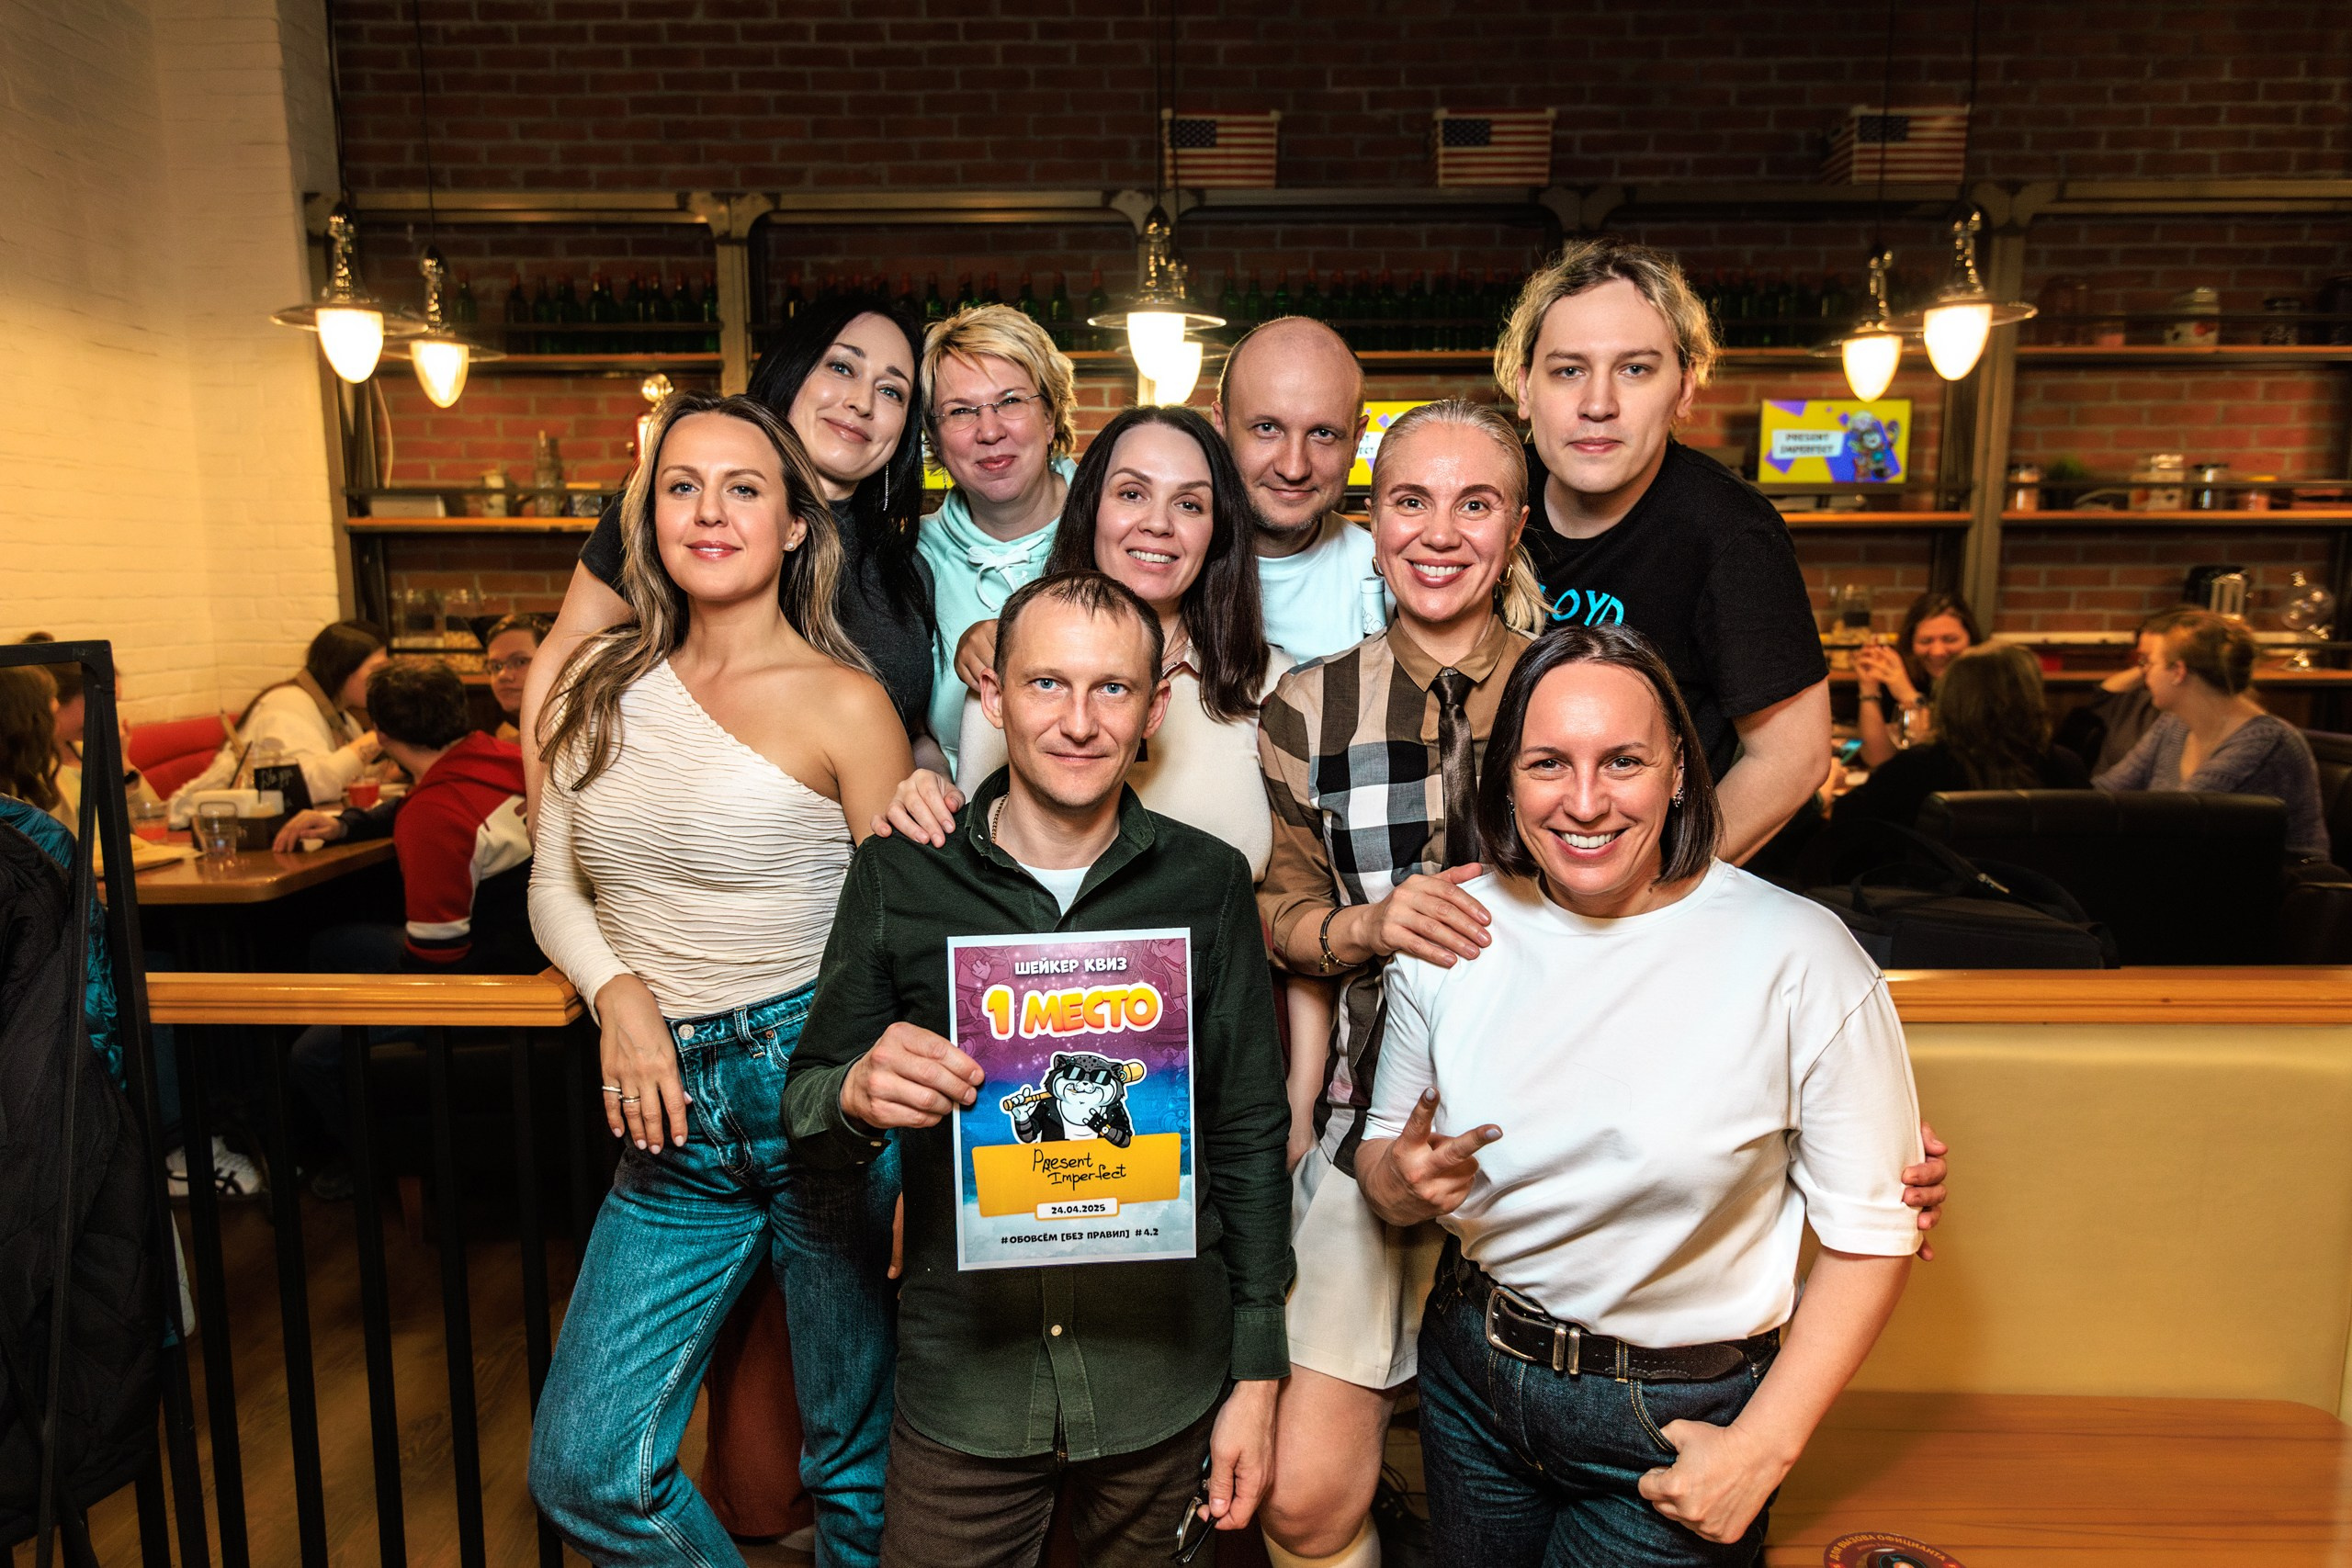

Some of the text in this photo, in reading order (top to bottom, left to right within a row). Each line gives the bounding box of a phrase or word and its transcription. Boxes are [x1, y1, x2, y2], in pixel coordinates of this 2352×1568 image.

[1538, 582, 1624, 627] OYD
[1014, 957, 1128, 976] ШЕЙКЕР КВИЗ
[986, 987, 1159, 1035] 1 МЕСТО
[1046, 1163, 1127, 1191] Imperfect
[1051, 1203, 1106, 1214] 24.04.2025
[1001, 1233, 1057, 1245] #ОБОВСЁМ
[1060, 1232, 1084, 1242] [БЕЗ
[1087, 1229, 1130, 1240] ПРАВИЛ]
[1829, 1546, 1843, 1562] ДЛЯ
[1838, 1534, 1876, 1549] ВЫЗОВА
[1876, 1534, 1946, 1562] ОФИЦИАНТА
